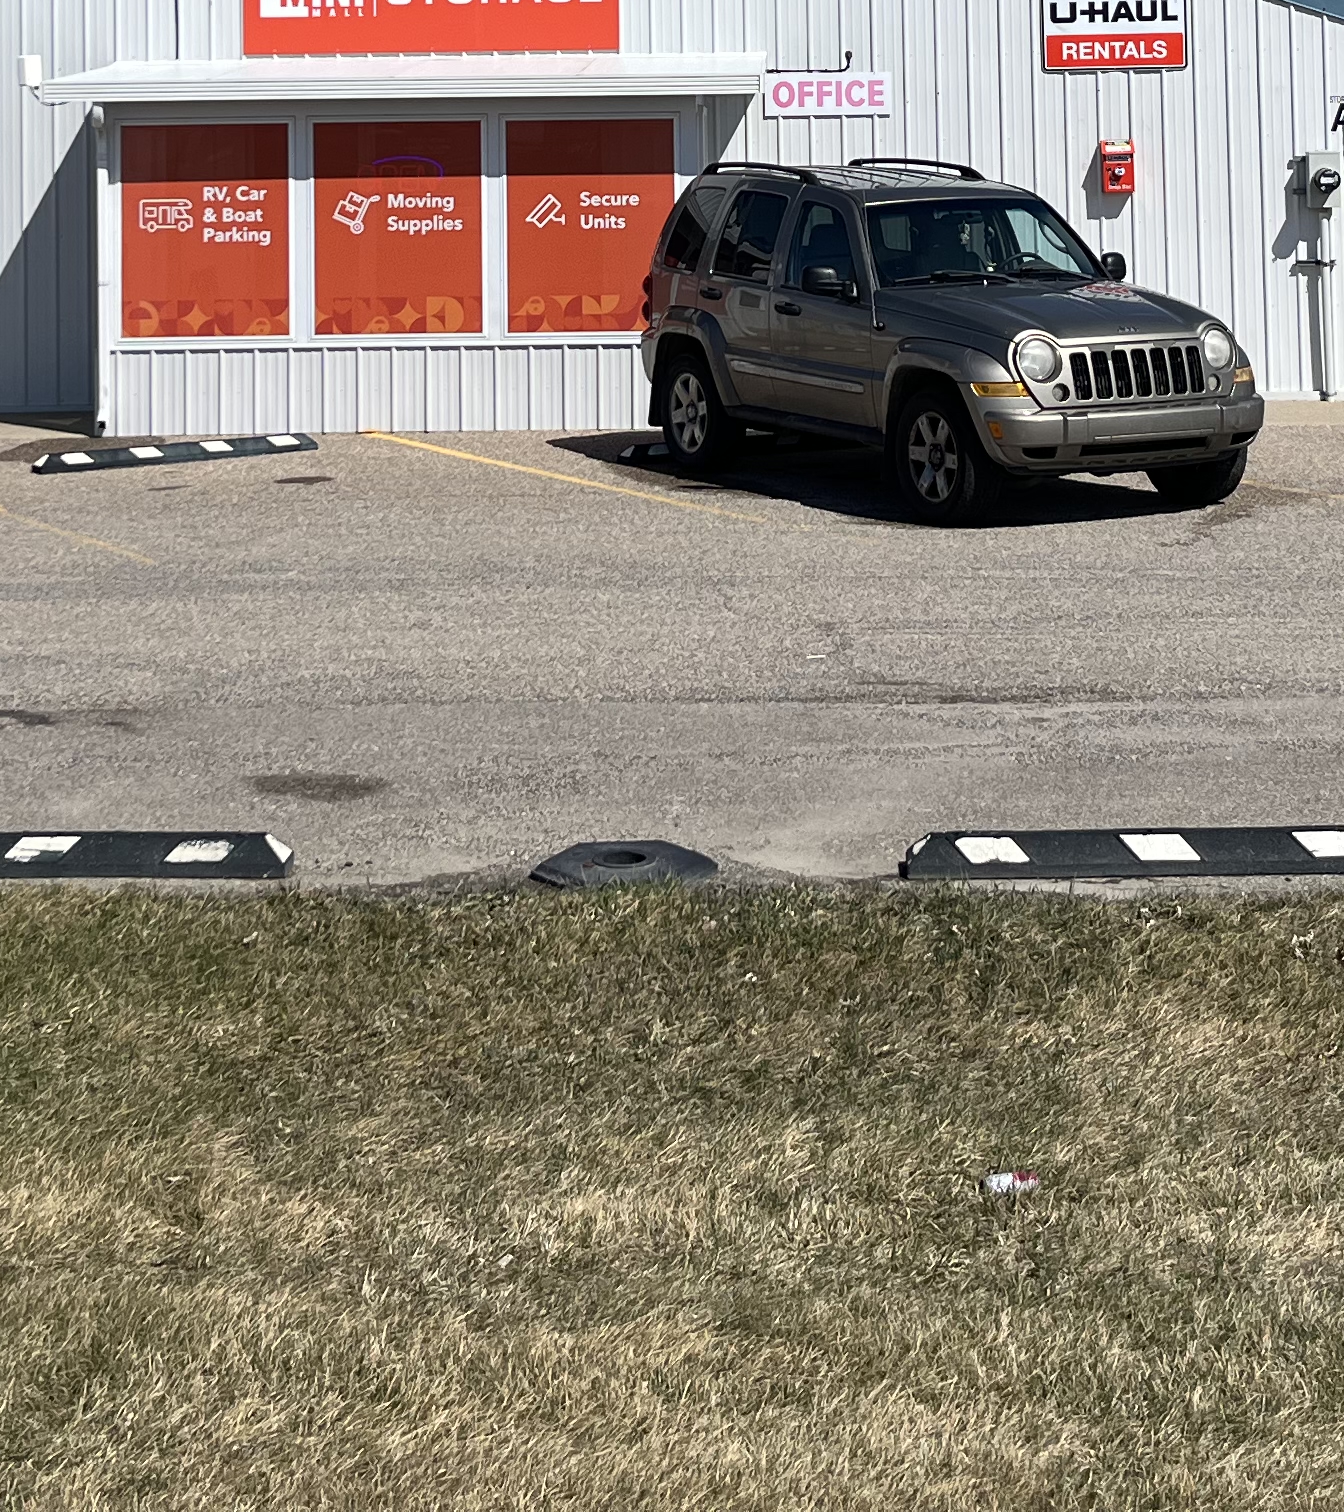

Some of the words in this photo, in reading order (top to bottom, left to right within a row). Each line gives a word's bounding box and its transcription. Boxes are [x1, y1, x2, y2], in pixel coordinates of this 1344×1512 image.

[311, 7, 364, 17] MALL
[1050, 0, 1178, 23] U-HAUL
[1061, 40, 1168, 60] RENTALS
[772, 80, 885, 108] OFFICE
[202, 185, 232, 204] RV,
[235, 185, 268, 202] Car
[387, 192, 455, 213] Moving
[579, 191, 640, 207] Secure
[202, 207, 218, 223] &
[221, 207, 264, 223] Boat
[387, 214, 464, 236] Supplies
[580, 213, 626, 230] Units
[202, 226, 271, 247] Parking
